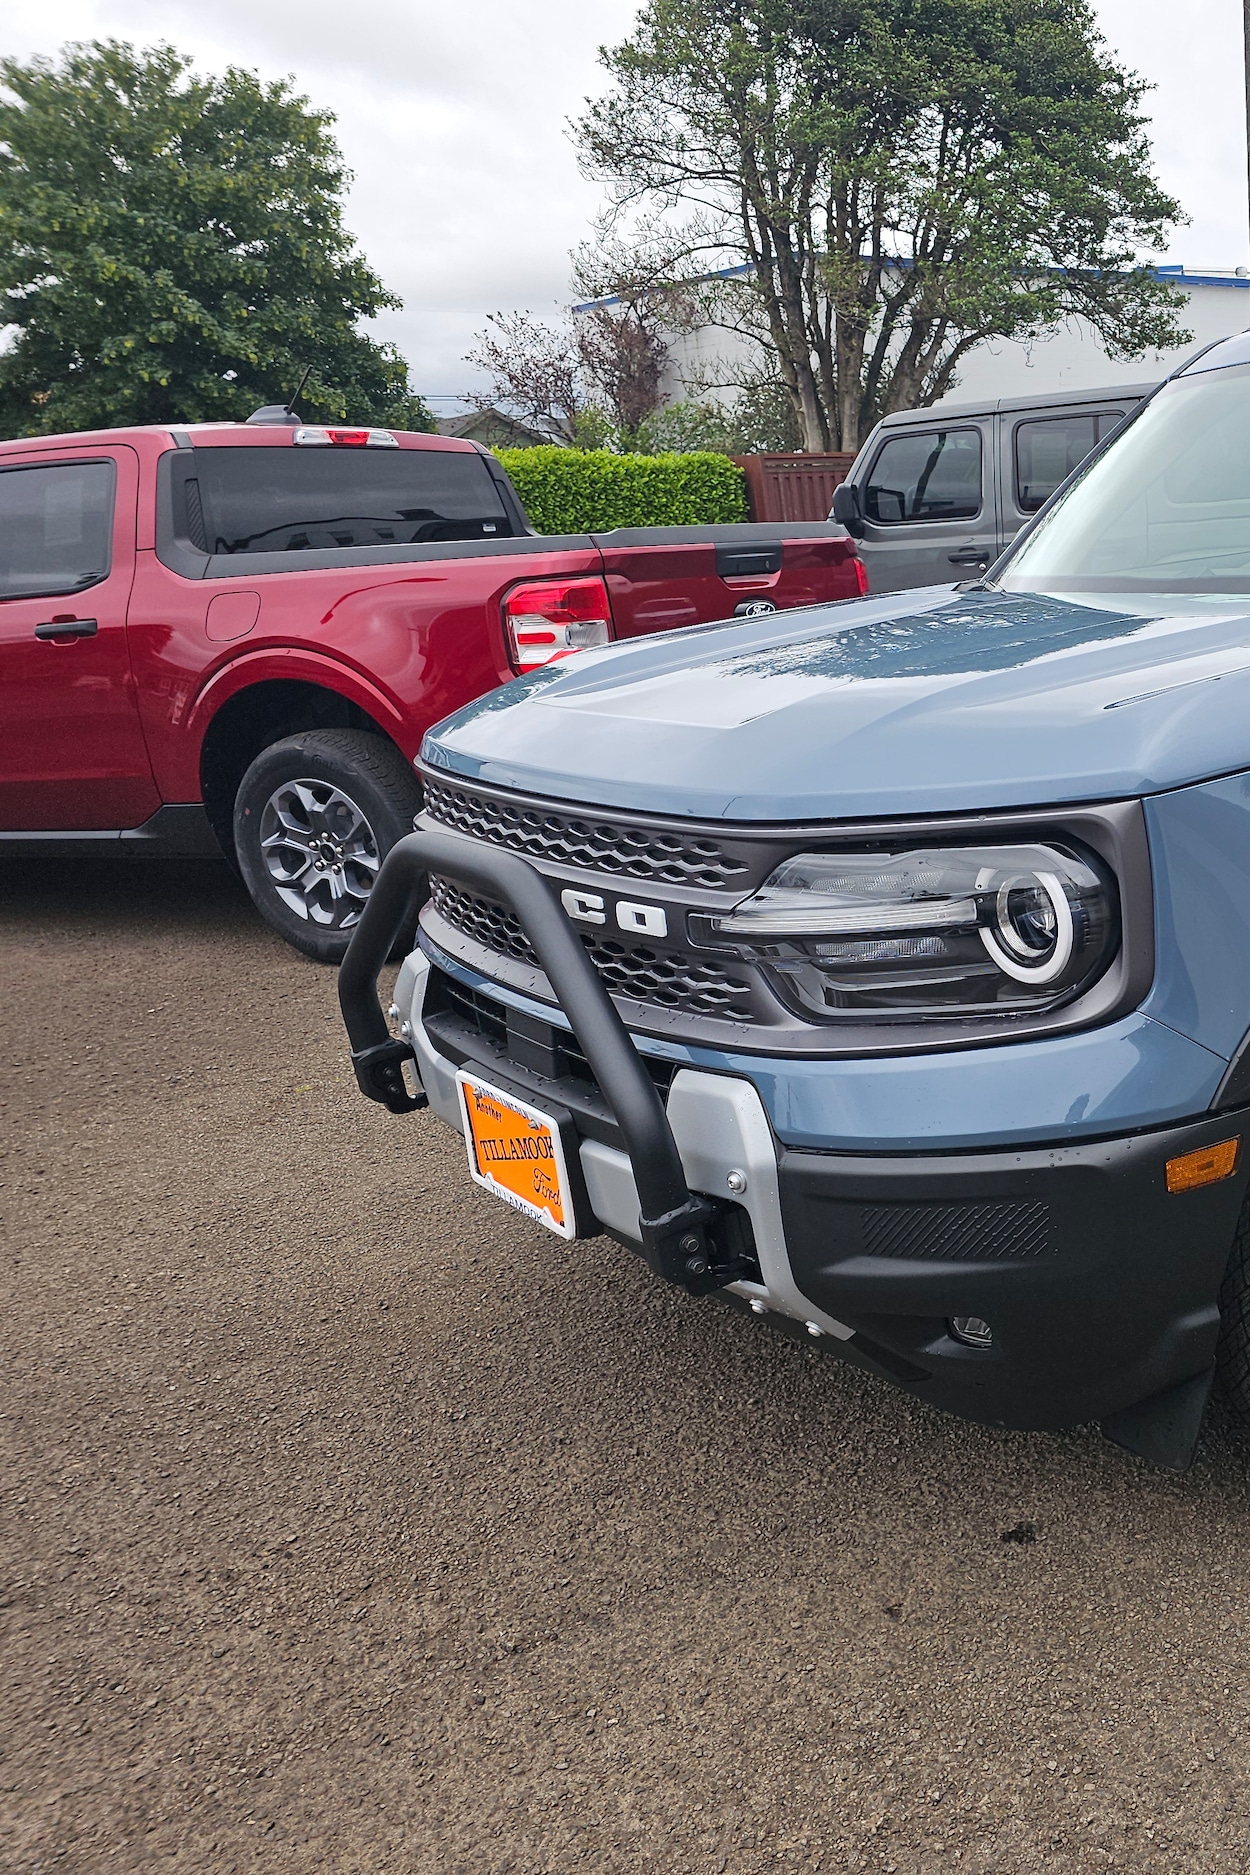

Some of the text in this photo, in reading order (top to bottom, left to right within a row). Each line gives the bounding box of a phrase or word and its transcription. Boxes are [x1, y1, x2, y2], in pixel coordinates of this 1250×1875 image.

[475, 1099, 502, 1123] Another
[490, 1183, 544, 1225] TILLAMOOK
[533, 1167, 562, 1207] Ford
